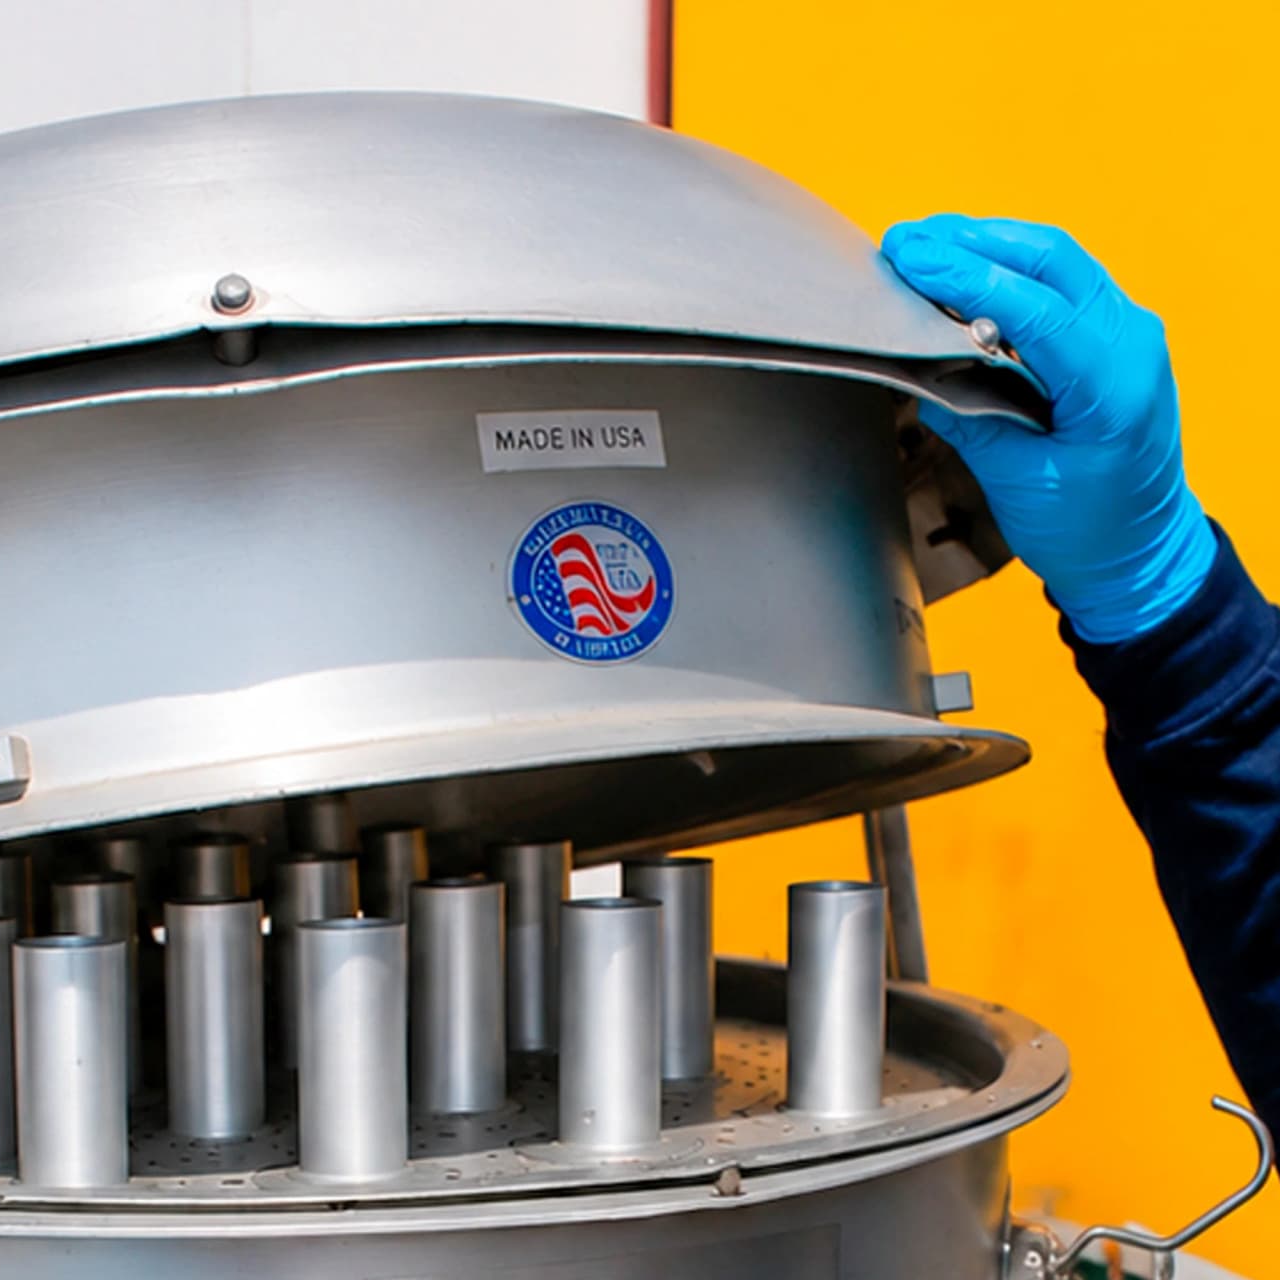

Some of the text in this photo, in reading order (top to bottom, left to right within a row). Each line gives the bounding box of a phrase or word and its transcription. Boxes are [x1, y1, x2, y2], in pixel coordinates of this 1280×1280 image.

[495, 426, 646, 451] MADE IN USA
